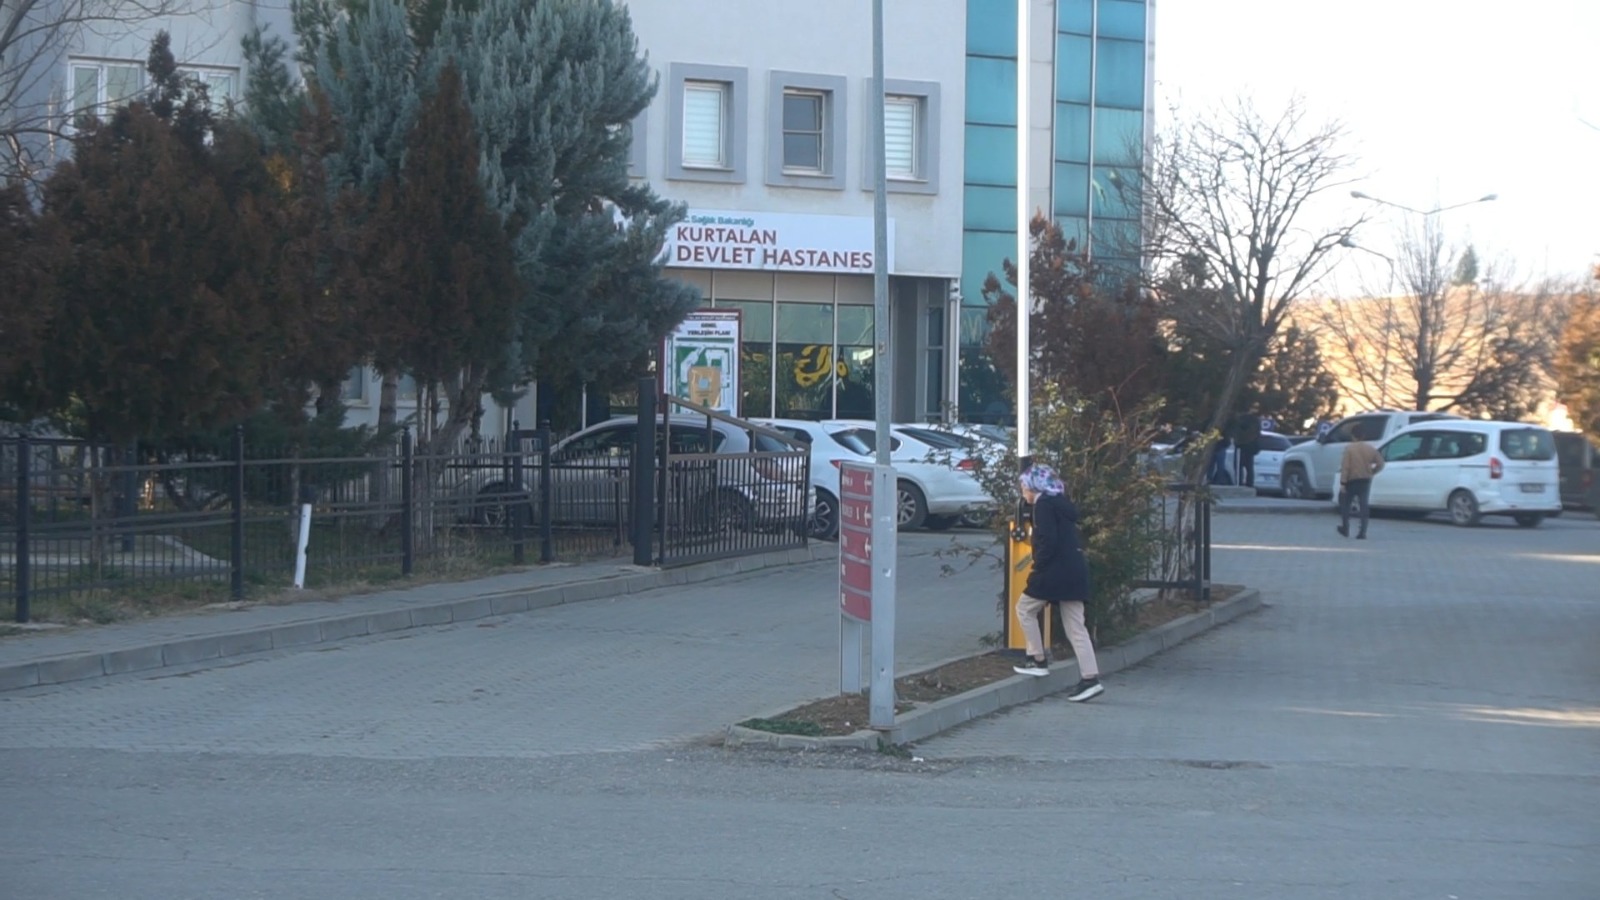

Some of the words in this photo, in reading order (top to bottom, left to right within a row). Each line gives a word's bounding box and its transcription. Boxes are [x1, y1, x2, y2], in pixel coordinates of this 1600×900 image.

[677, 226, 777, 245] KURTALAN
[677, 245, 756, 265] DEVLET
[763, 248, 873, 269] HASTANES
